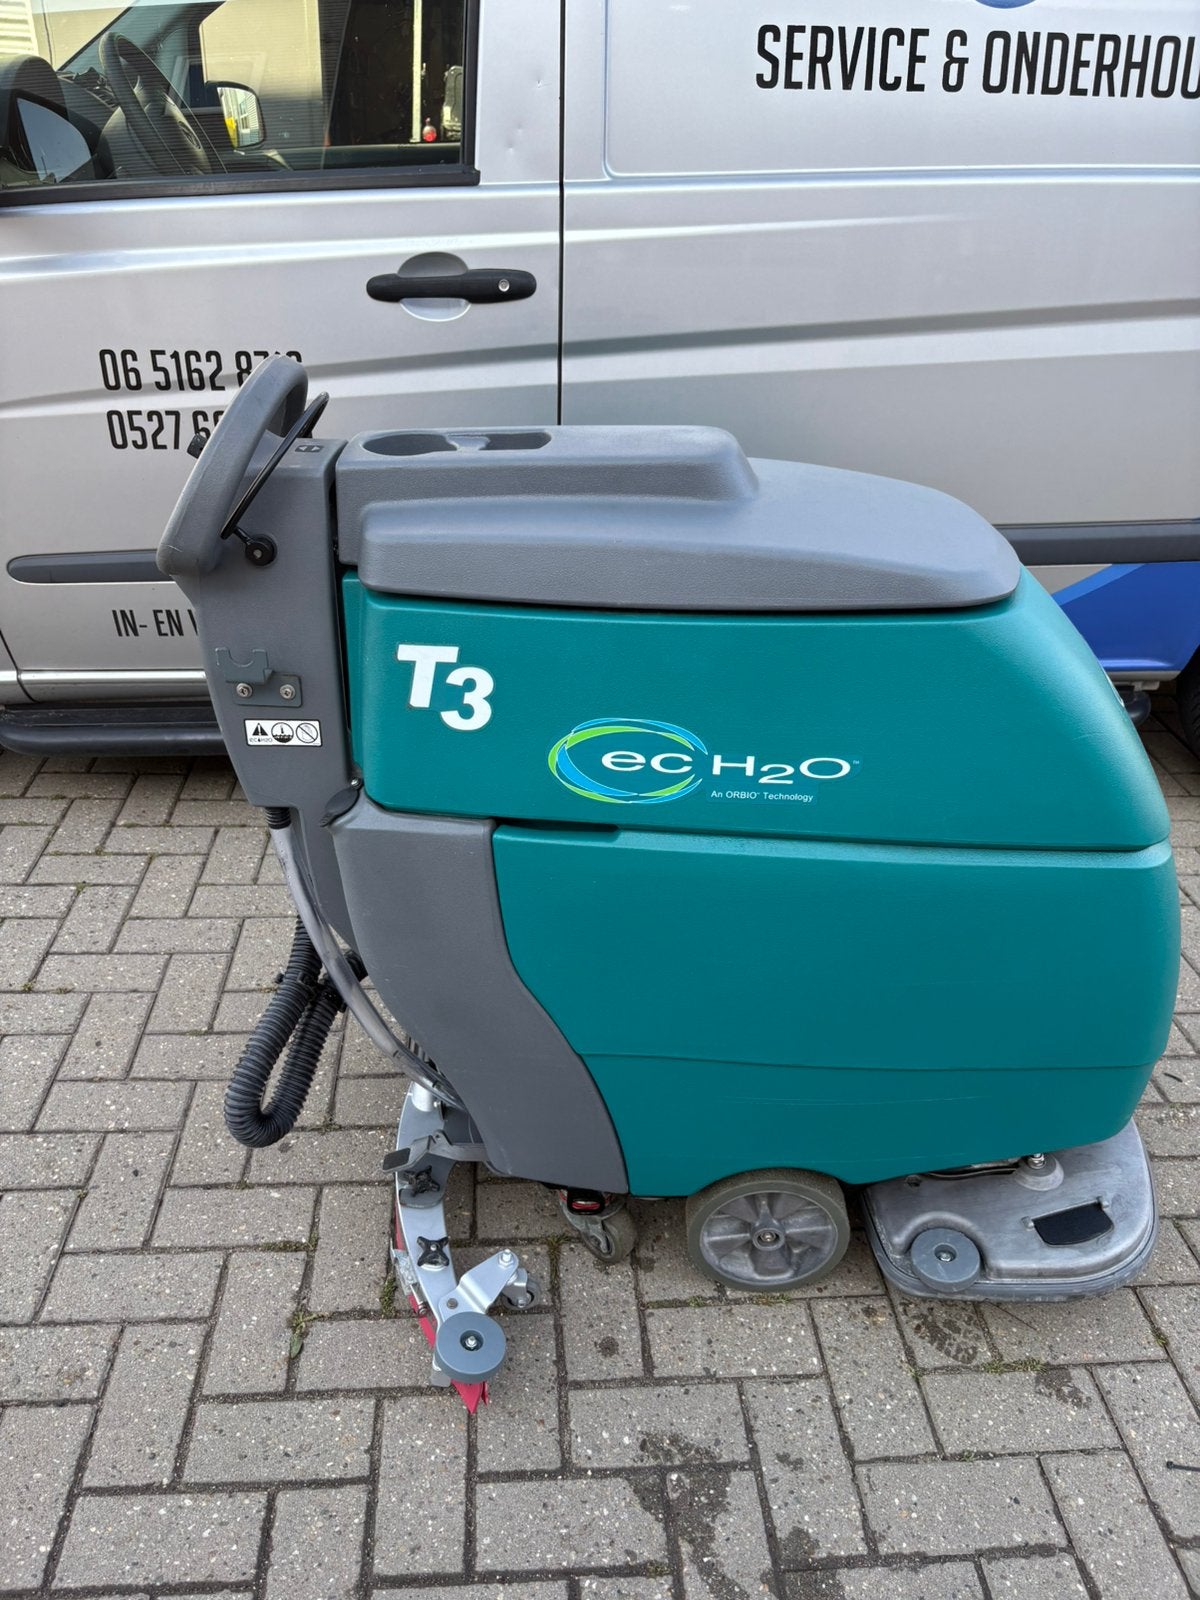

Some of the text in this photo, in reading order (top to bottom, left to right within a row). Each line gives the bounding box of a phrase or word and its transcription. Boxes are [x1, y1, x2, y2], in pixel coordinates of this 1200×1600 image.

[756, 24, 930, 92] SERVICE
[941, 29, 969, 94] &
[99, 348, 142, 391] 06
[149, 349, 226, 392] 5162
[106, 409, 181, 450] 0527
[111, 608, 148, 637] IN-
[152, 608, 184, 637] EN
[396, 643, 494, 731] T3
[710, 790, 723, 798] An
[763, 792, 814, 802] Technology
